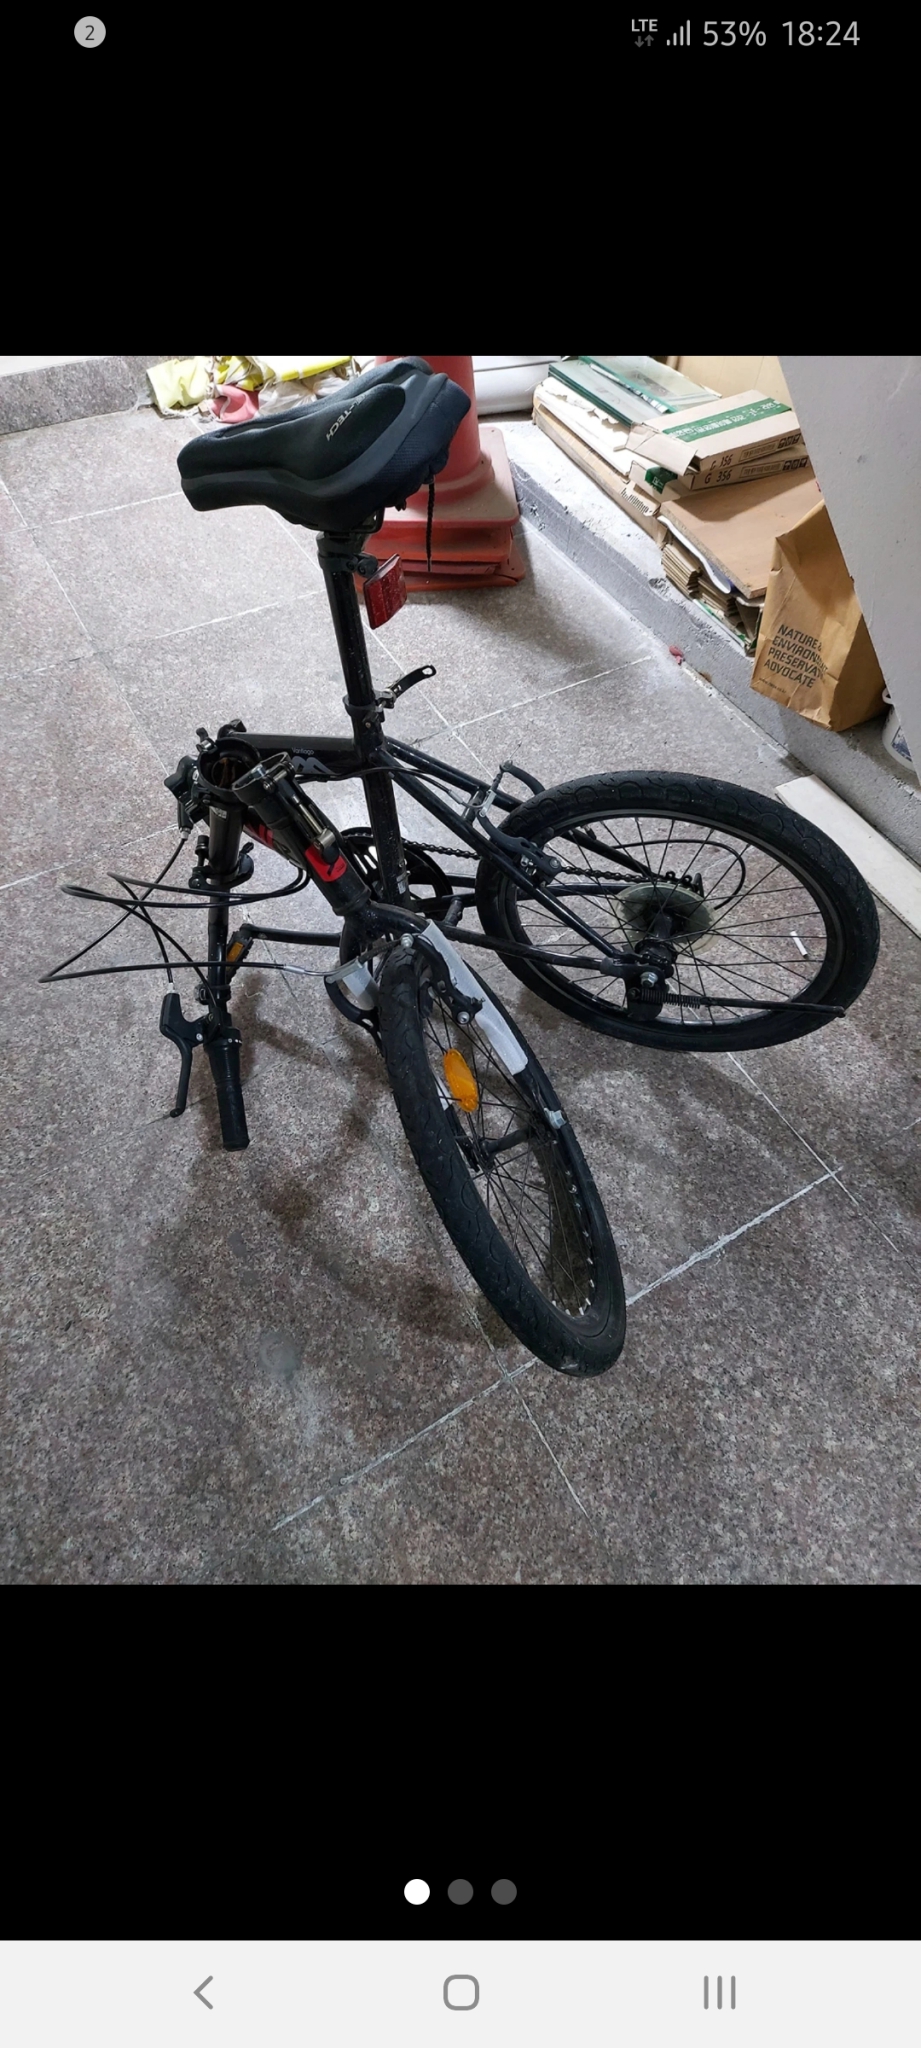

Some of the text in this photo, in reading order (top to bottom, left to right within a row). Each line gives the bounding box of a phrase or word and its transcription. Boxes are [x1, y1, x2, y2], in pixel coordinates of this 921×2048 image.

[704, 473, 712, 484] G
[716, 469, 733, 482] 356
[777, 624, 819, 650] NATURE
[764, 659, 816, 688] ADVOCATE
